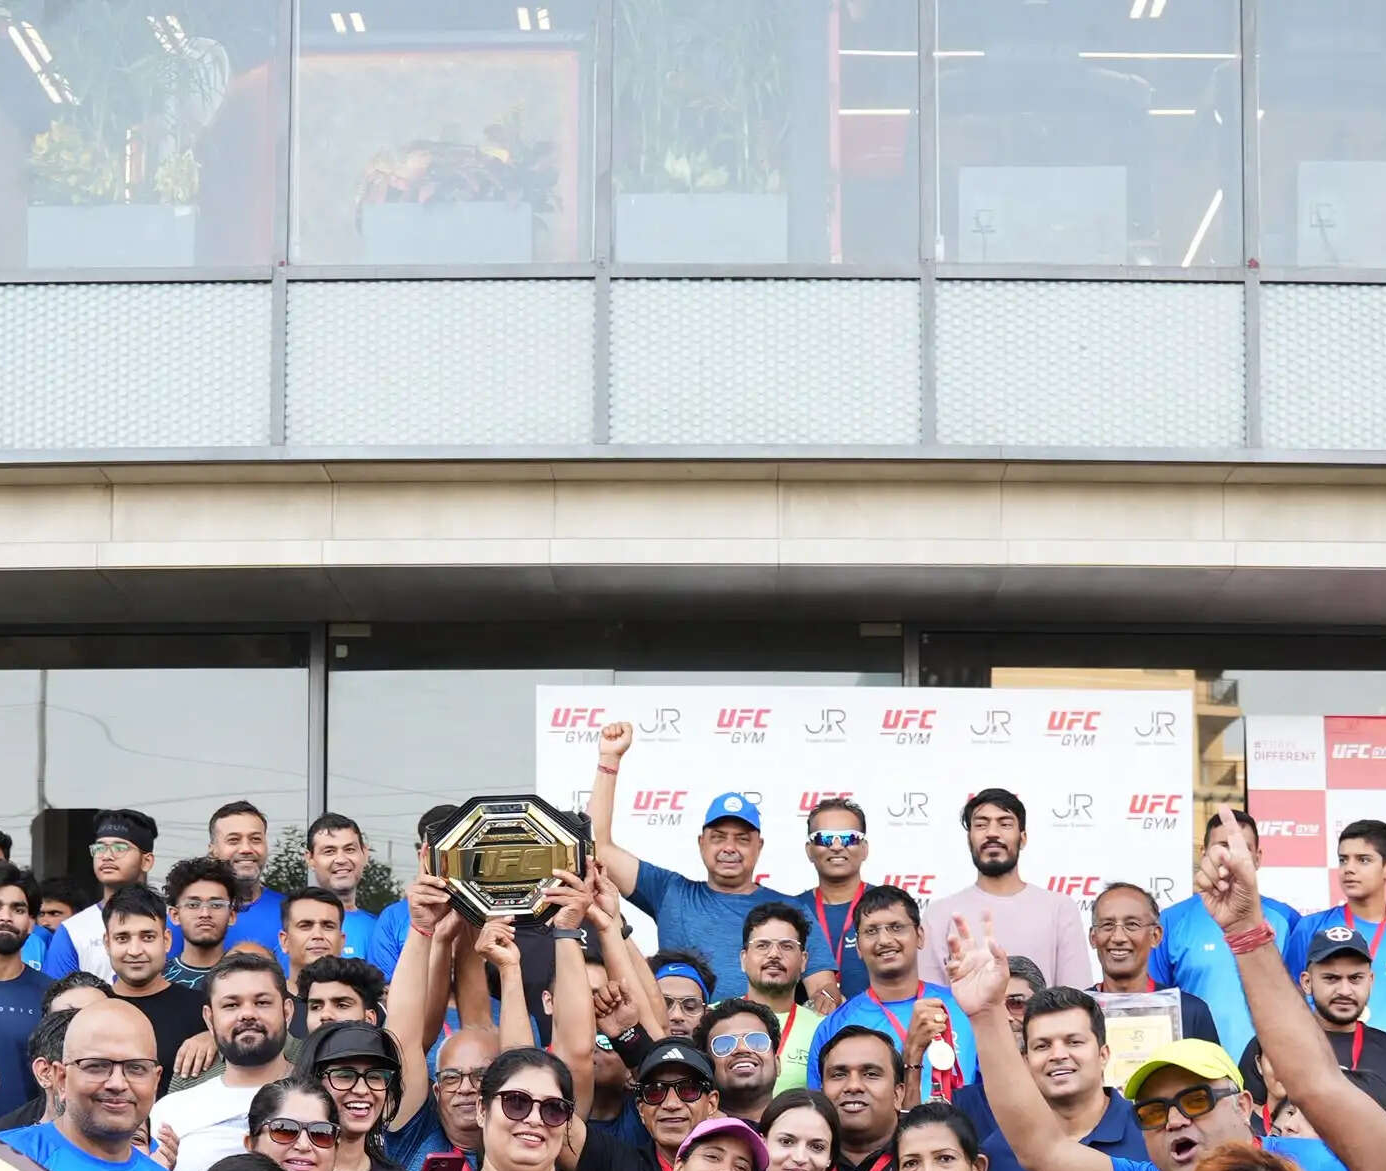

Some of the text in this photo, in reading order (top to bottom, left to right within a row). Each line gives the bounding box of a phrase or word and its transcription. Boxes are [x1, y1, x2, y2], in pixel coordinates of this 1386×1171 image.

[551, 708, 605, 727] UFC
[717, 708, 772, 728] UFC
[882, 709, 937, 729] UFC
[1047, 711, 1101, 731] UFC
[565, 731, 600, 743] GYM
[731, 731, 765, 743] GYM
[896, 733, 931, 745] GYM
[1061, 734, 1096, 746] GYM
[1253, 751, 1317, 761] DIFFERENT
[1332, 744, 1371, 759] UFC
[633, 791, 688, 811] UFC
[1129, 795, 1183, 814] UFC
[647, 813, 682, 826] GYM
[1143, 818, 1177, 830] GYM
[1257, 820, 1295, 836] UFC
